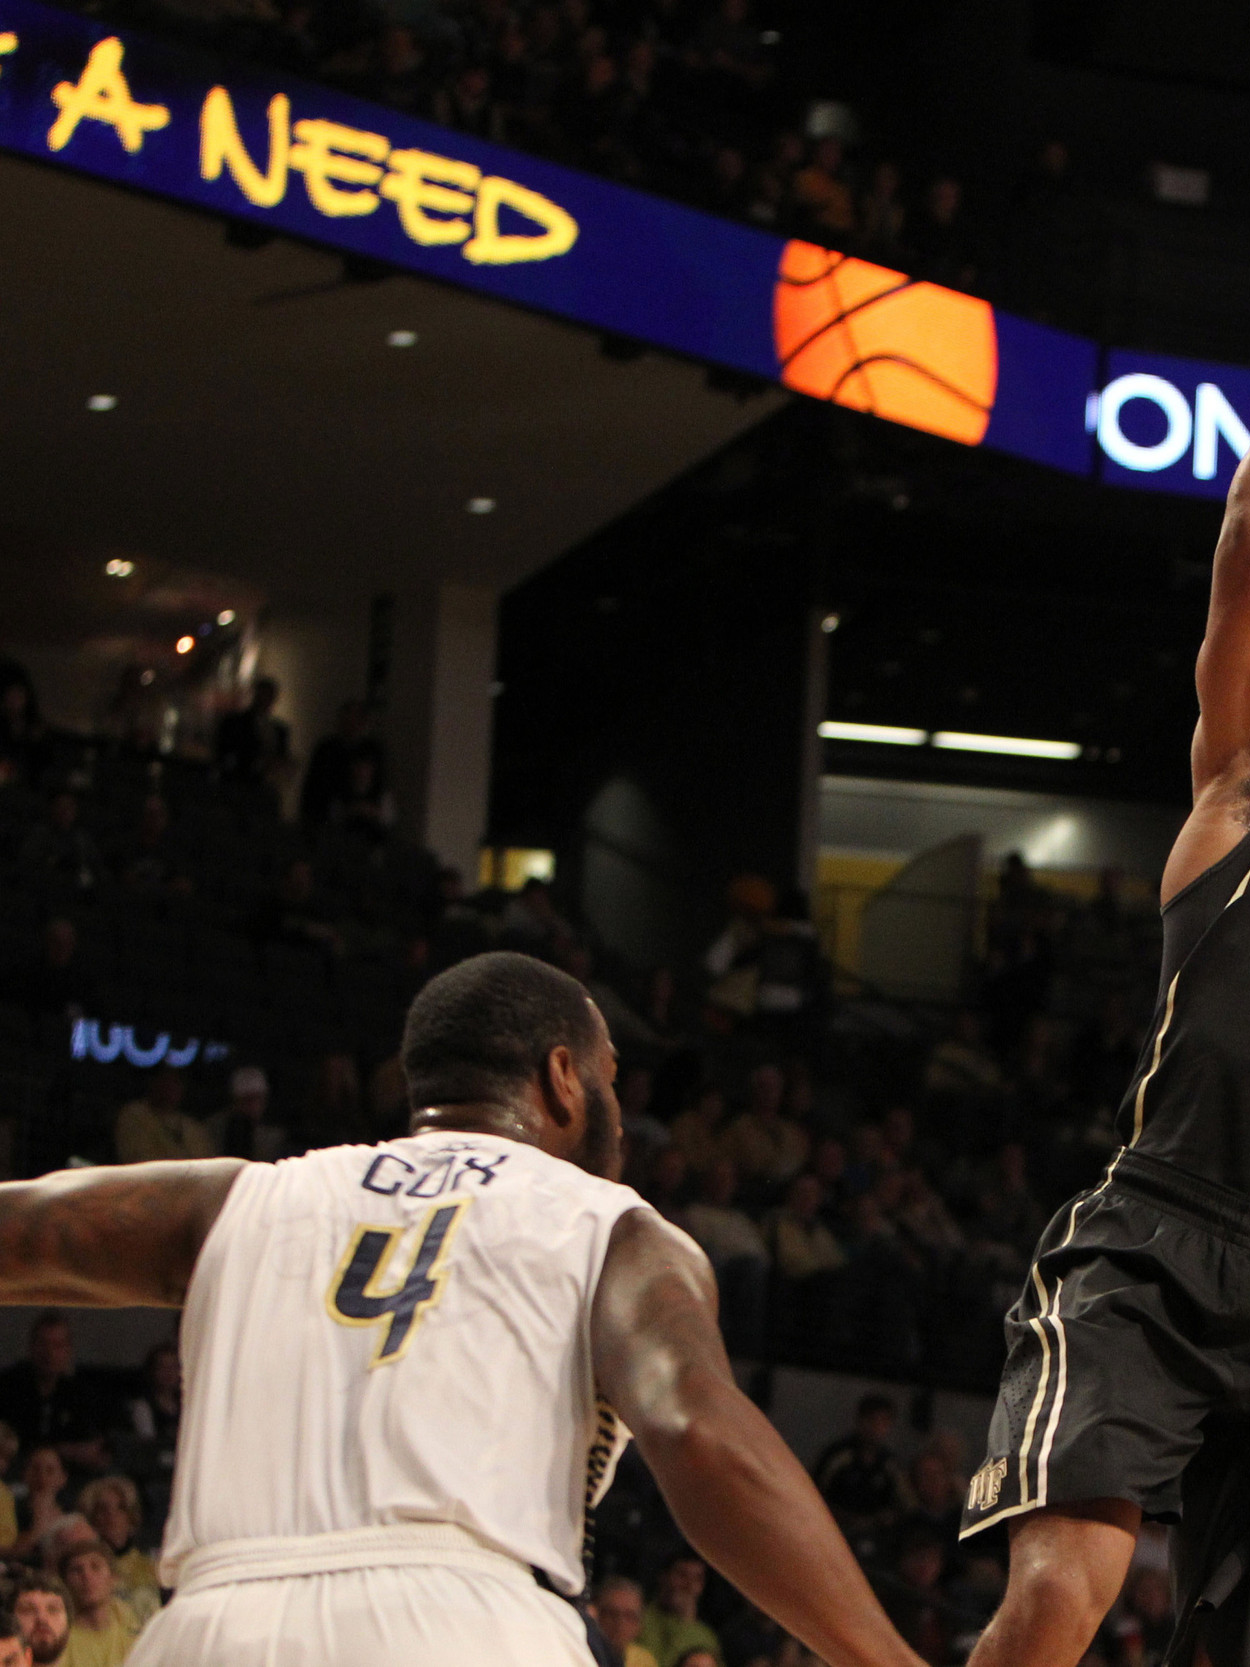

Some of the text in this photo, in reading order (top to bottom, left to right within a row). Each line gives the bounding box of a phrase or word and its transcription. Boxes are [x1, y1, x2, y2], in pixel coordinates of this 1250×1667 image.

[47, 36, 579, 264] A NEED
[361, 1153, 509, 1198] COX
[325, 1197, 474, 1370] 4
